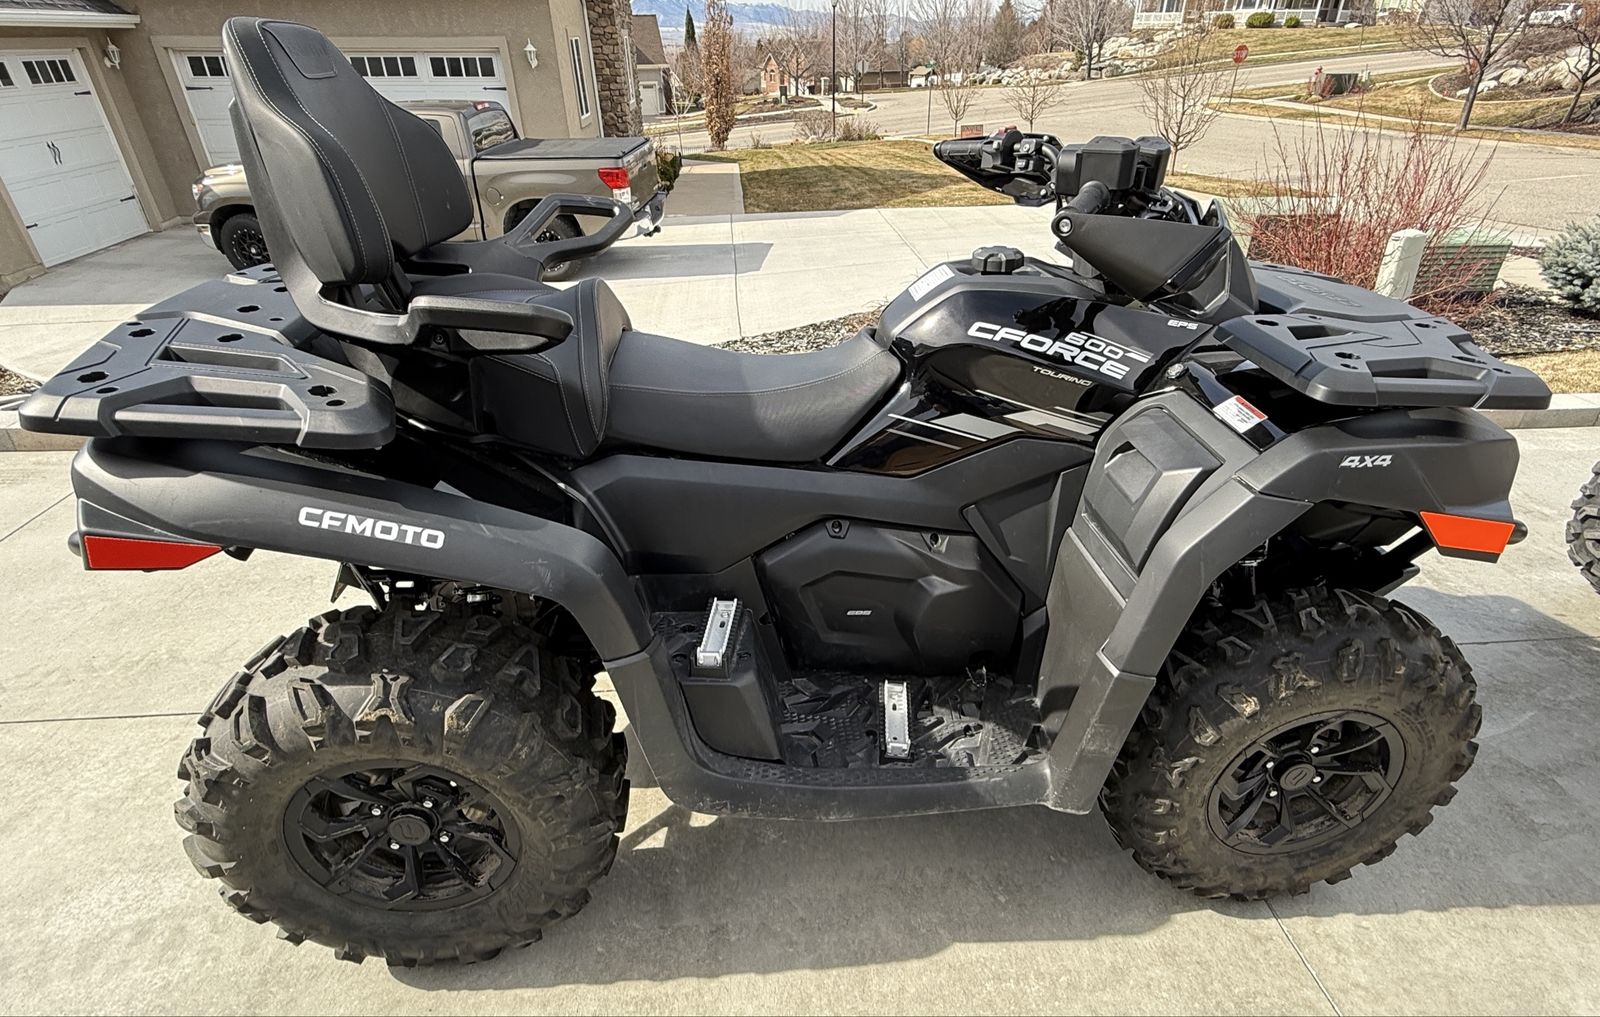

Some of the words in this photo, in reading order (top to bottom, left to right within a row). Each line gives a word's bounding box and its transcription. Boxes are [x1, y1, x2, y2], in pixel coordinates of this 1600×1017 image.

[1167, 319, 1199, 330] EPS
[967, 321, 1131, 380] CFORCE
[1064, 331, 1125, 360] 600
[1032, 365, 1094, 387] TOURING
[298, 506, 446, 550] CFMOTO
